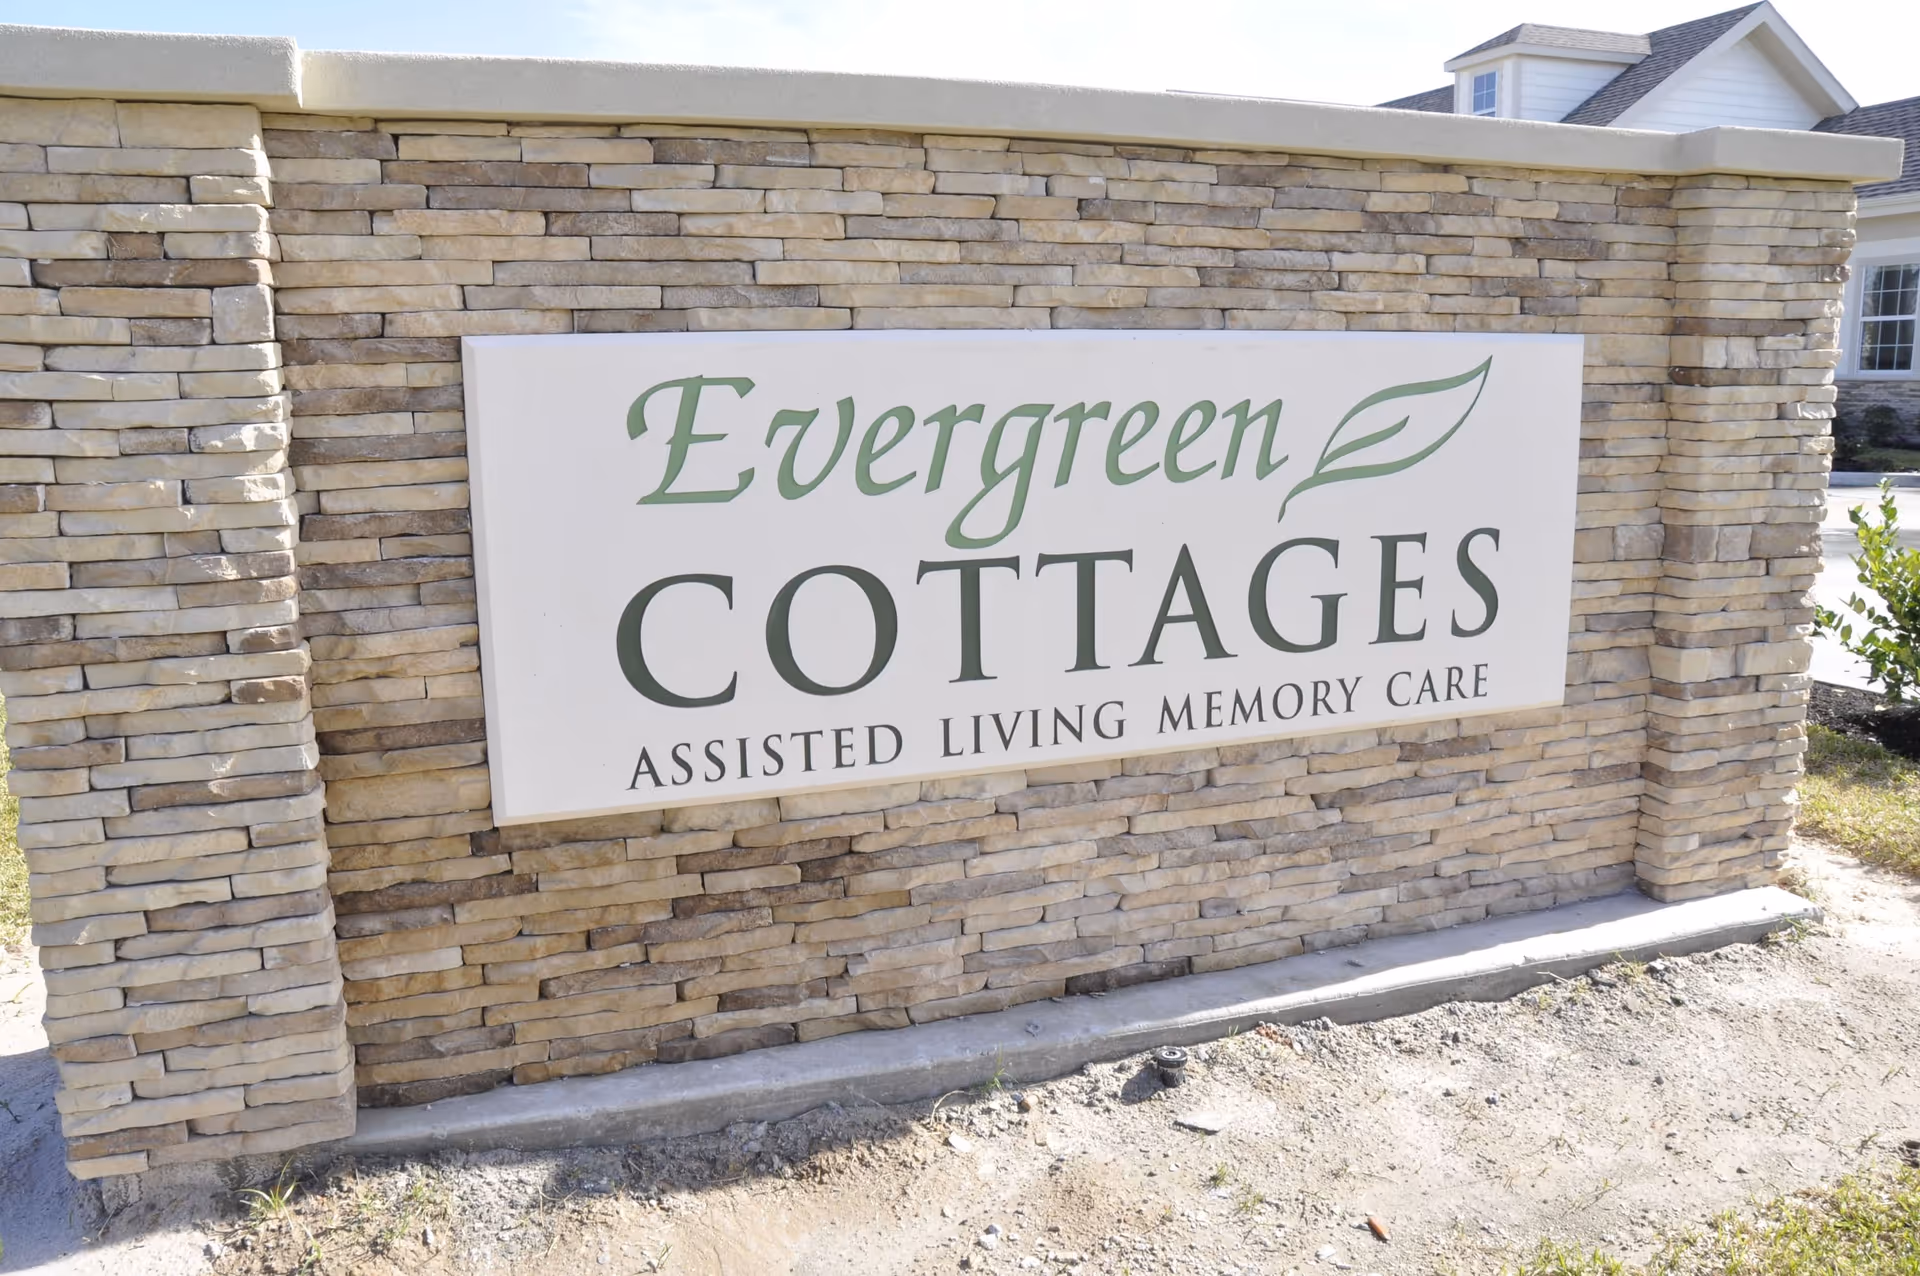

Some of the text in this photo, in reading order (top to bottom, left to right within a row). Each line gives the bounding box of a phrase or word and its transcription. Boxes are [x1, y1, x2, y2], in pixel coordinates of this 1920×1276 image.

[627, 374, 1289, 550] Evergreen
[615, 527, 1501, 709] COTTAGES
[627, 663, 1489, 791] ASSISTED LIVING MEMORY CARE
